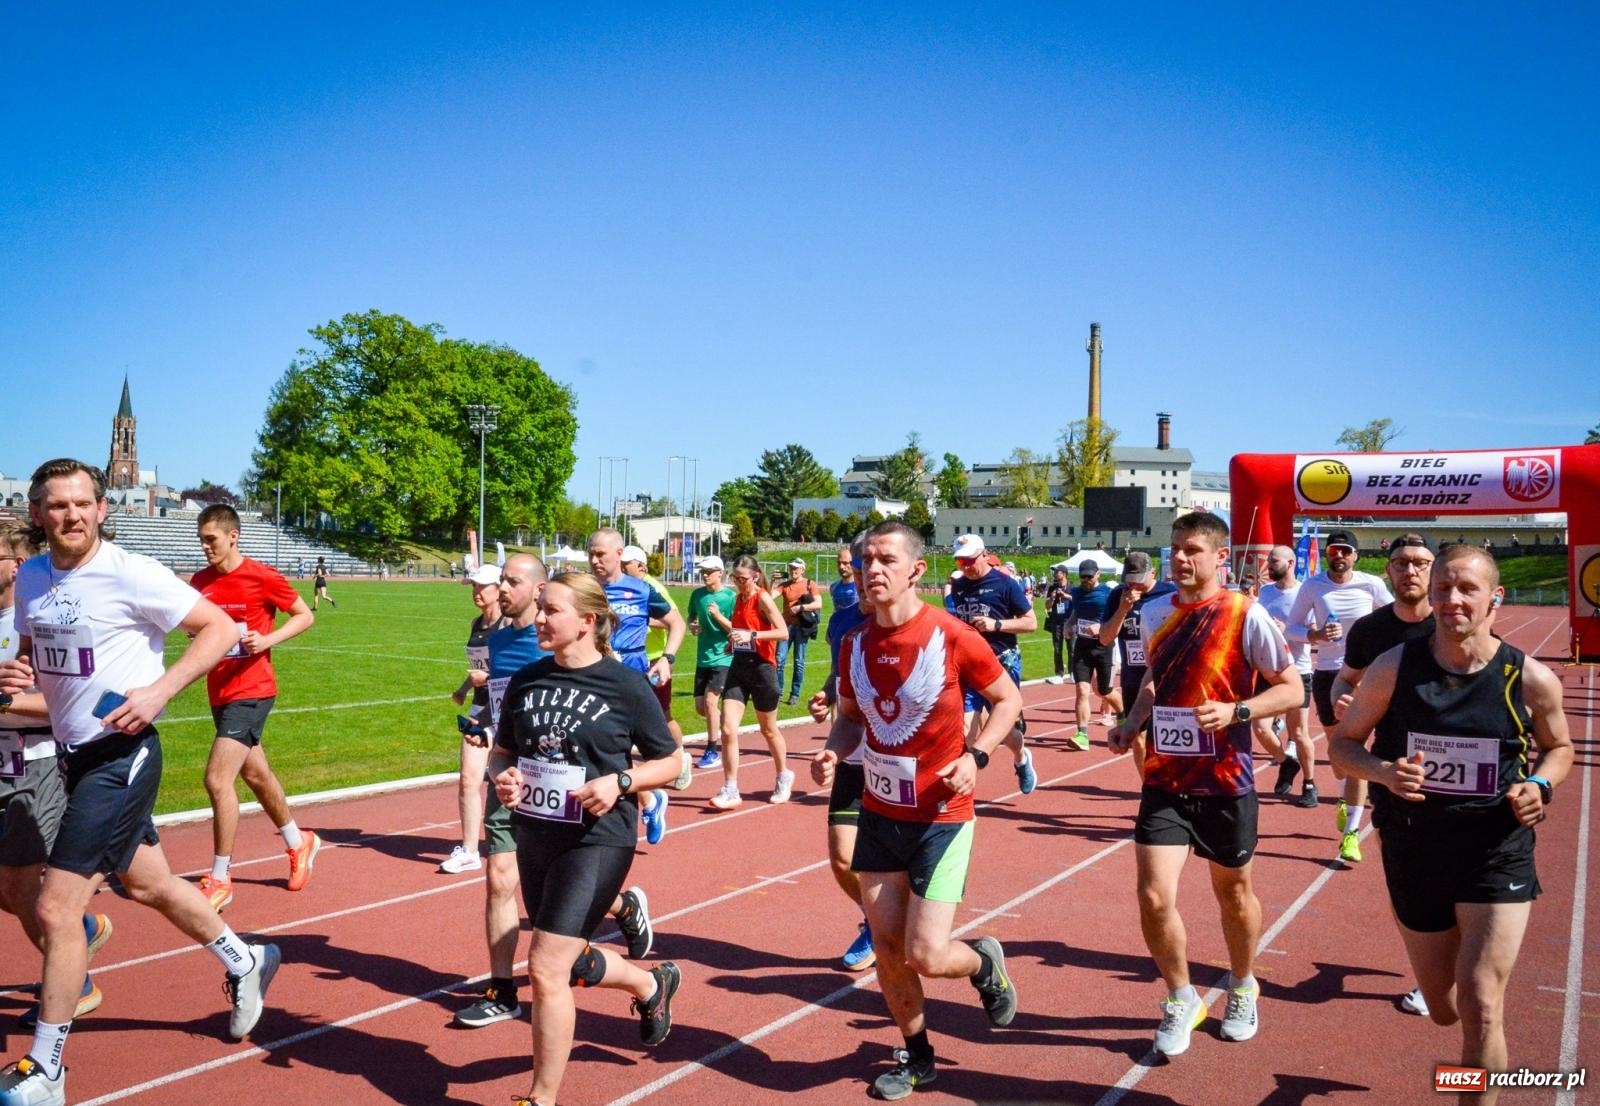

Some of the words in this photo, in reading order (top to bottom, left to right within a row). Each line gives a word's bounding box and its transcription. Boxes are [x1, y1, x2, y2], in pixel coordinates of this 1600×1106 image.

[1399, 458, 1448, 469] BIEG
[1365, 475, 1404, 488] BEZ
[1409, 473, 1482, 487] GRANIC
[1375, 490, 1473, 505] RACIBÓRZ
[44, 646, 68, 668] 117
[1132, 651, 1145, 661] 23
[523, 688, 610, 721] MICKEY
[532, 711, 582, 733] MOUSE
[1160, 727, 1194, 747] 229
[868, 769, 892, 795] 173
[1424, 760, 1466, 785] 221
[521, 783, 560, 810] 206
[222, 944, 243, 963] LOTTO
[50, 1037, 64, 1067] LOTTO
